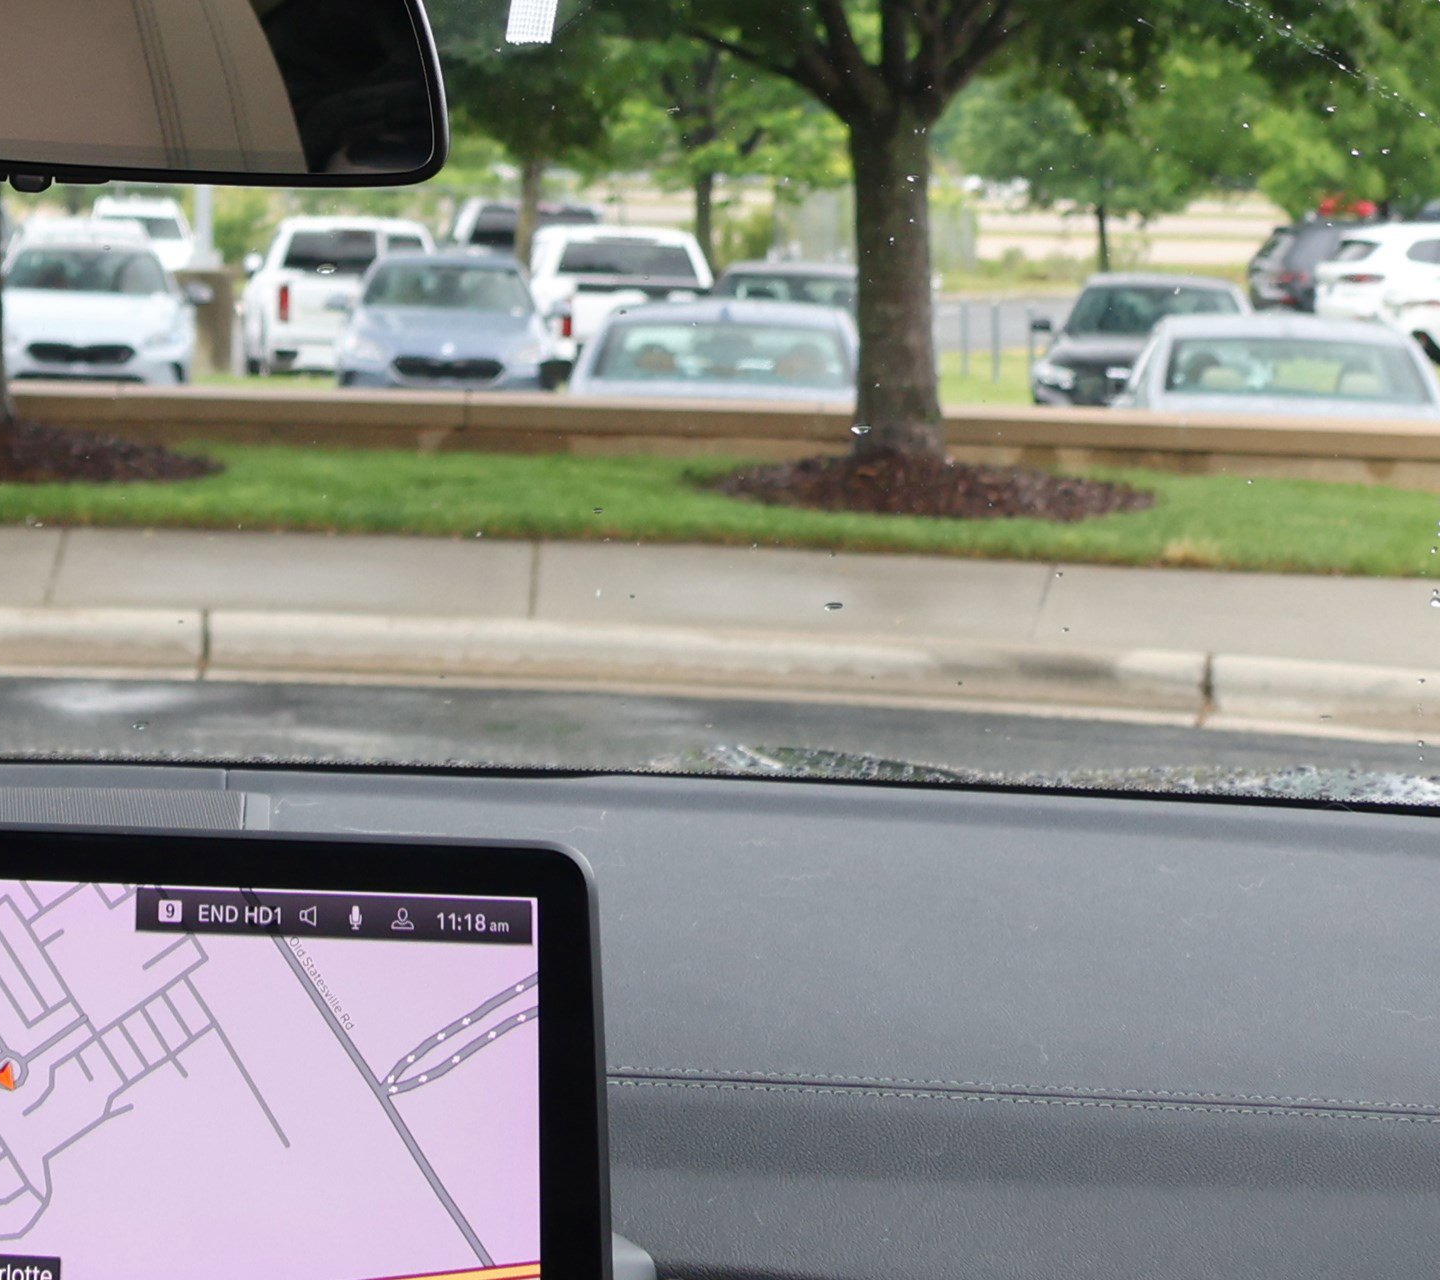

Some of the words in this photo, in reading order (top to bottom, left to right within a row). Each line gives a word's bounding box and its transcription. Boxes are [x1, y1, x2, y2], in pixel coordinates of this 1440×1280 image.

[164, 903, 176, 920] 9
[198, 904, 239, 924] END
[244, 905, 283, 925] HD1
[436, 912, 486, 932] 11:18
[489, 919, 510, 933] am
[288, 935, 308, 960] Old
[302, 955, 344, 1016] Statesville
[339, 1011, 355, 1032] Rd
